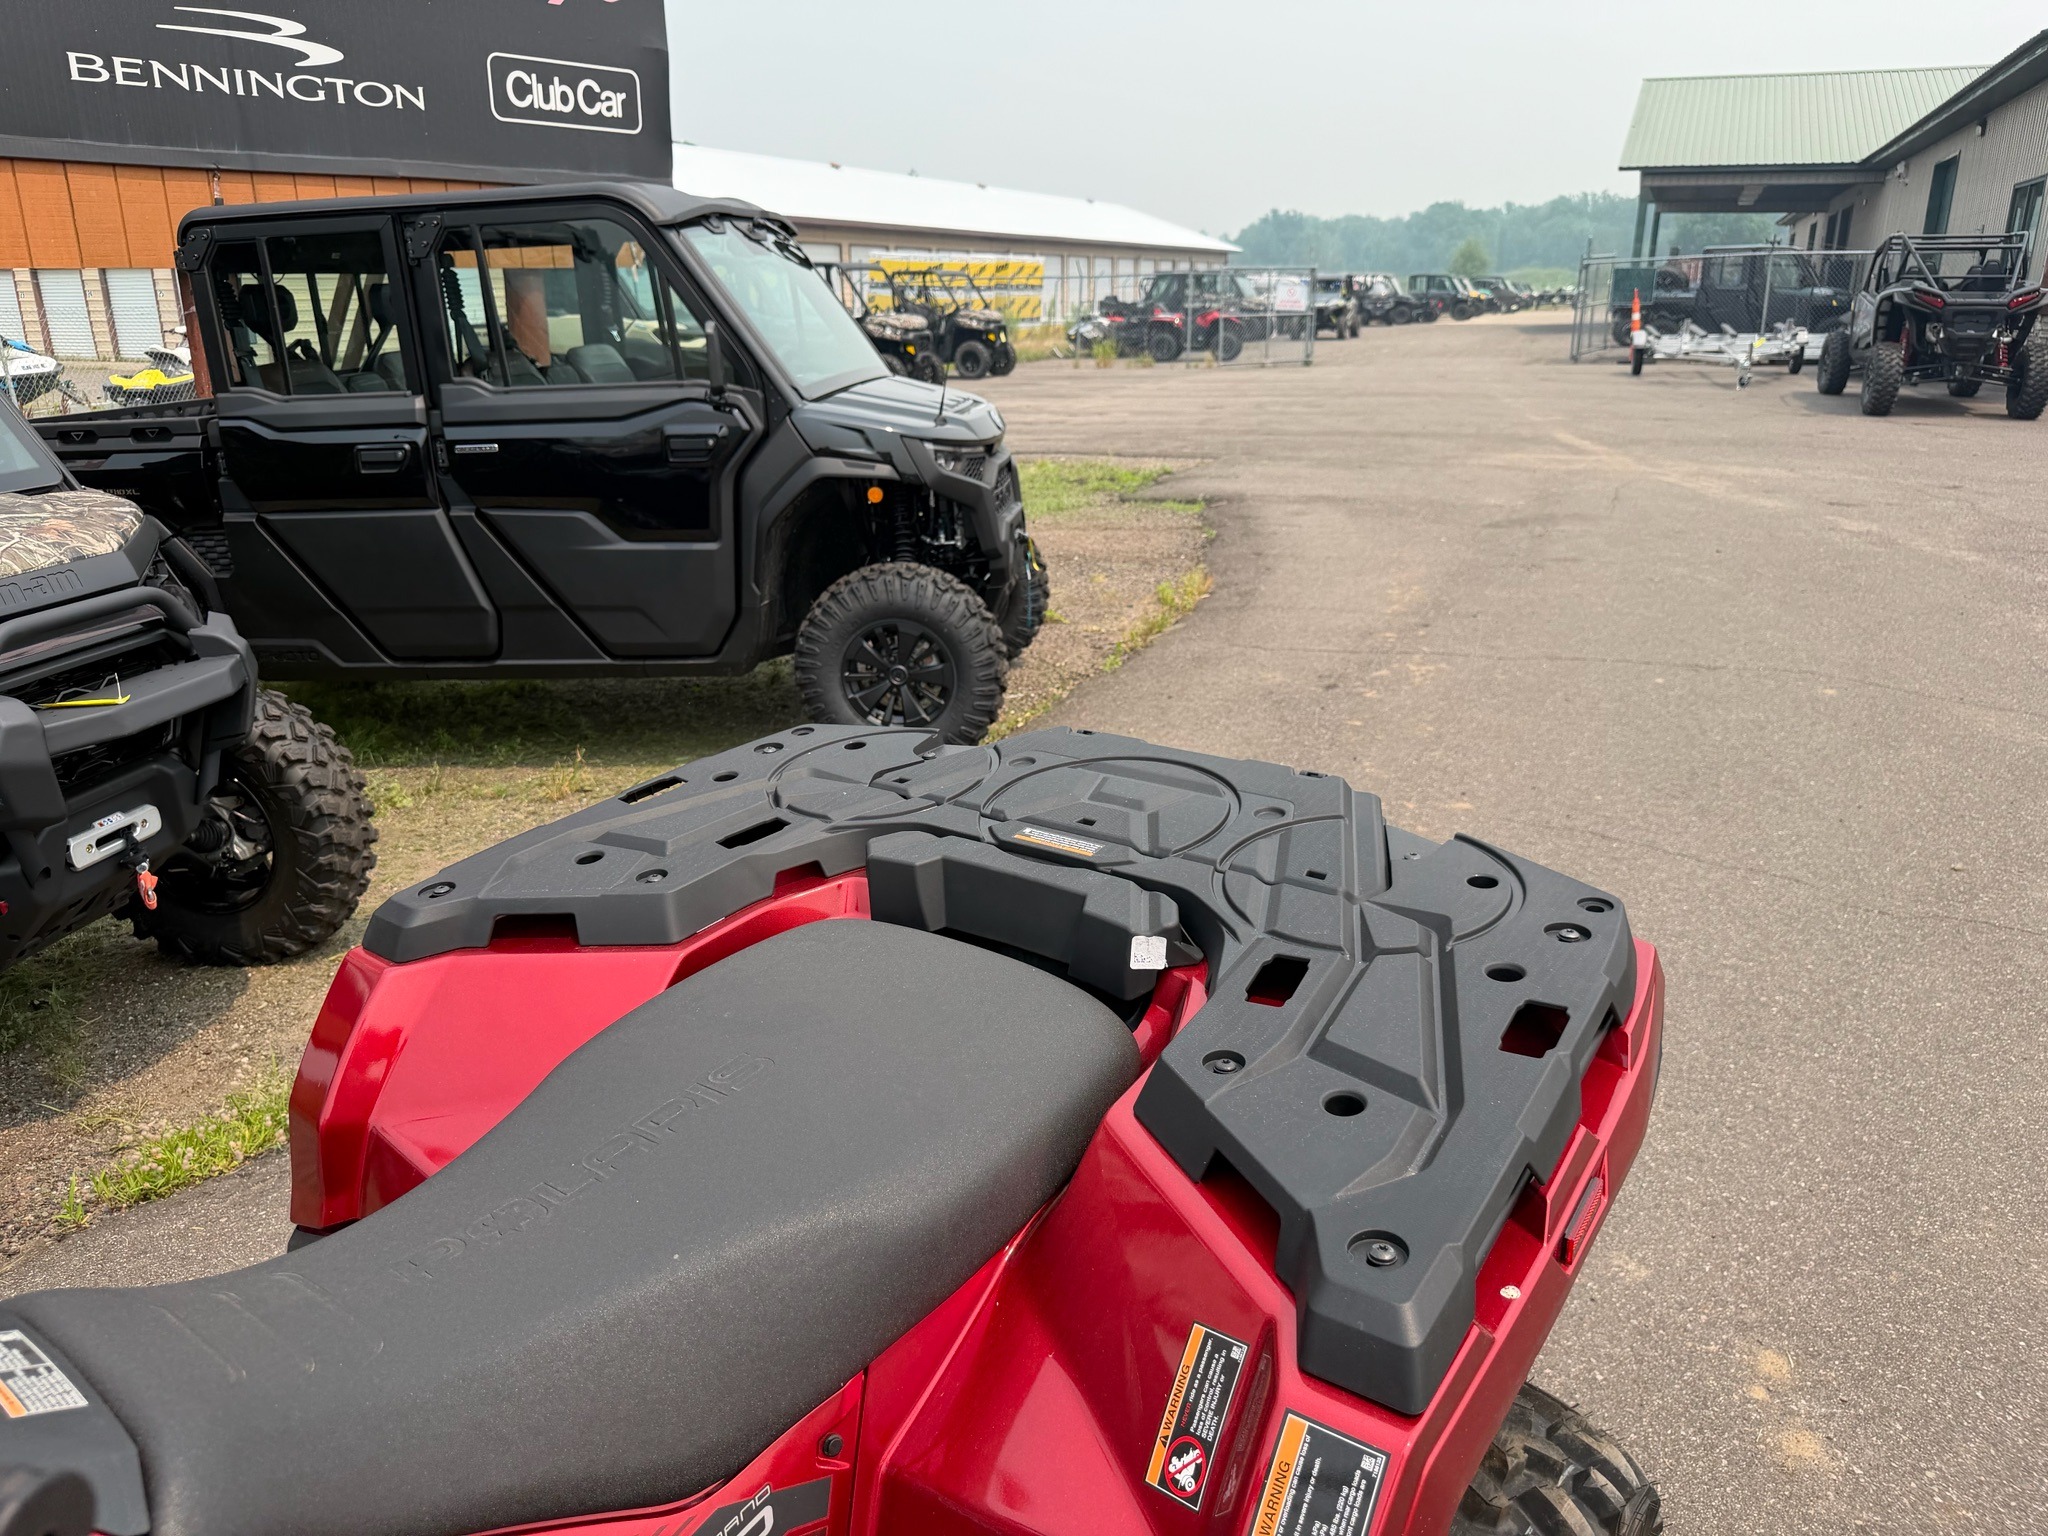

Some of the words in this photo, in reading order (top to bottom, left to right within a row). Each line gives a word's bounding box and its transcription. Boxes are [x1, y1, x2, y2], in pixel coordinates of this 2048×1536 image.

[66, 51, 425, 111] BENNINGTON
[506, 70, 575, 113] Club
[577, 79, 627, 118] Car
[0, 569, 84, 605] n-am
[388, 1052, 776, 1284] POLARIS
[1181, 1402, 1191, 1428] NEVER
[1194, 1379, 1199, 1388] as
[1199, 1338, 1213, 1374] passenger.
[1196, 1421, 1204, 1436] loss
[1201, 1412, 1206, 1420] of
[1204, 1387, 1215, 1412] control,
[1212, 1357, 1225, 1386] resulting
[1221, 1349, 1227, 1357] in
[1163, 1364, 1190, 1430] WARNING
[1190, 1393, 1206, 1433] Passengers
[1207, 1359, 1217, 1379] cause
[1201, 1409, 1214, 1439] SEVERE
[1210, 1382, 1222, 1410] INJURY
[1220, 1374, 1225, 1382] or
[1207, 1415, 1219, 1442] DEATH.
[1306, 1434, 1311, 1442] of
[1300, 1443, 1308, 1456] loss
[1295, 1456, 1305, 1476] cause
[1312, 1456, 1322, 1477] death.
[1310, 1476, 1316, 1484] or
[1351, 1470, 1361, 1487] loads
[1259, 1461, 1291, 1536] WARNING
[1303, 1484, 1315, 1503] injury
[1340, 1485, 1349, 1497] kg)
[1347, 1487, 1356, 1505] cargo
[1354, 1490, 1364, 1507] loads
[716, 1485, 771, 1536] AND
[1281, 1488, 1296, 1525] overloading
[1298, 1502, 1308, 1524] severe
[1336, 1496, 1345, 1511] (220
[1332, 1513, 1341, 1524] lbs.
[1339, 1518, 1347, 1535] when
[1350, 1508, 1359, 1526] cargo
[1279, 1525, 1284, 1533] or
[1295, 1524, 1302, 1532] in
